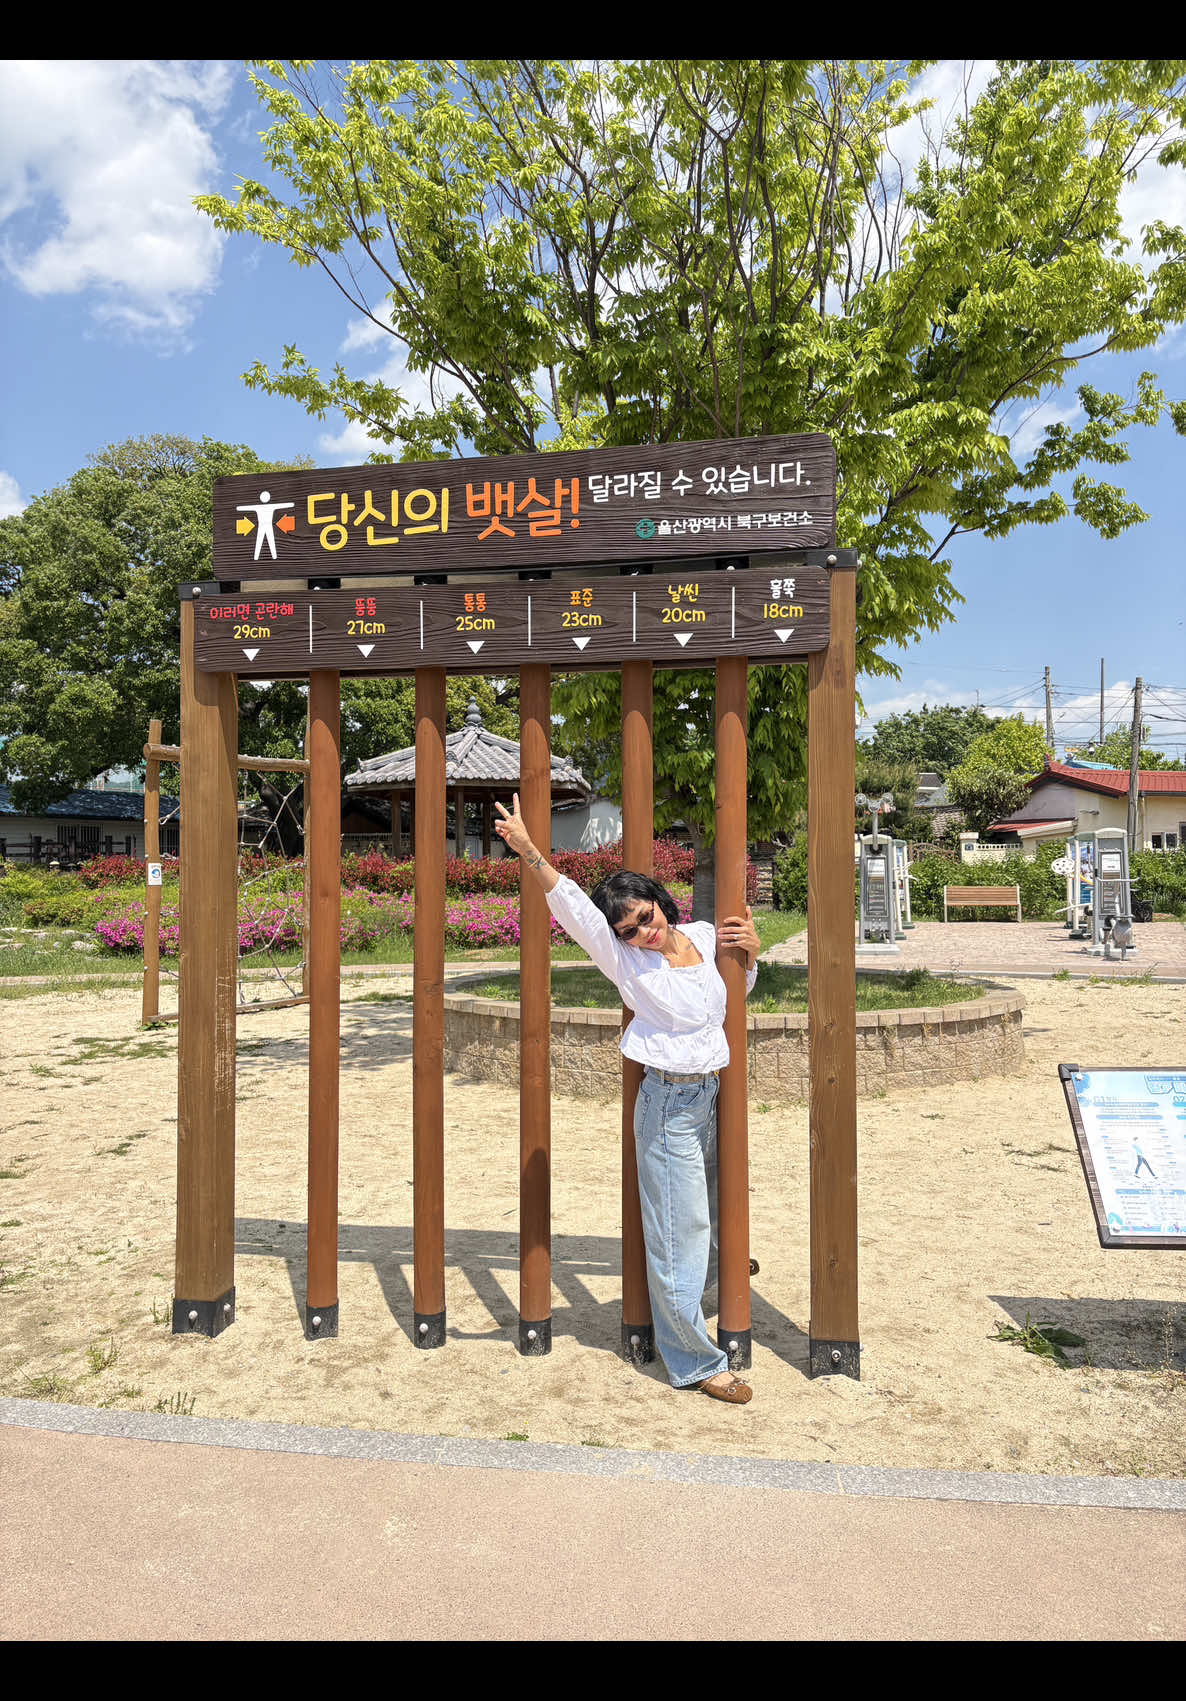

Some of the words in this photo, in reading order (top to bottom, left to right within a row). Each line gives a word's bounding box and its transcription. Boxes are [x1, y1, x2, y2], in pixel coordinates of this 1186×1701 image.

[307, 487, 449, 551] 당신의
[465, 477, 580, 541] 뱃살!
[588, 471, 662, 503] 달라질
[671, 469, 694, 497] 수
[701, 461, 812, 495] 있습니다.
[657, 516, 732, 535] 울산광역시
[737, 510, 813, 529] 북구보건소
[570, 588, 594, 608] 표준
[668, 583, 699, 604] 날씬
[770, 578, 796, 600] 홀쭉
[209, 603, 250, 621] 이러면
[255, 602, 294, 620] 곤란해
[355, 597, 377, 617] 뚱뚱
[464, 592, 487, 613] 통통
[763, 603, 803, 619] 18cm
[456, 615, 495, 631] 25cm
[561, 611, 602, 627] 23cm
[661, 607, 706, 624] 20cm
[233, 624, 271, 639] 29cm
[347, 620, 385, 635] 27cm
